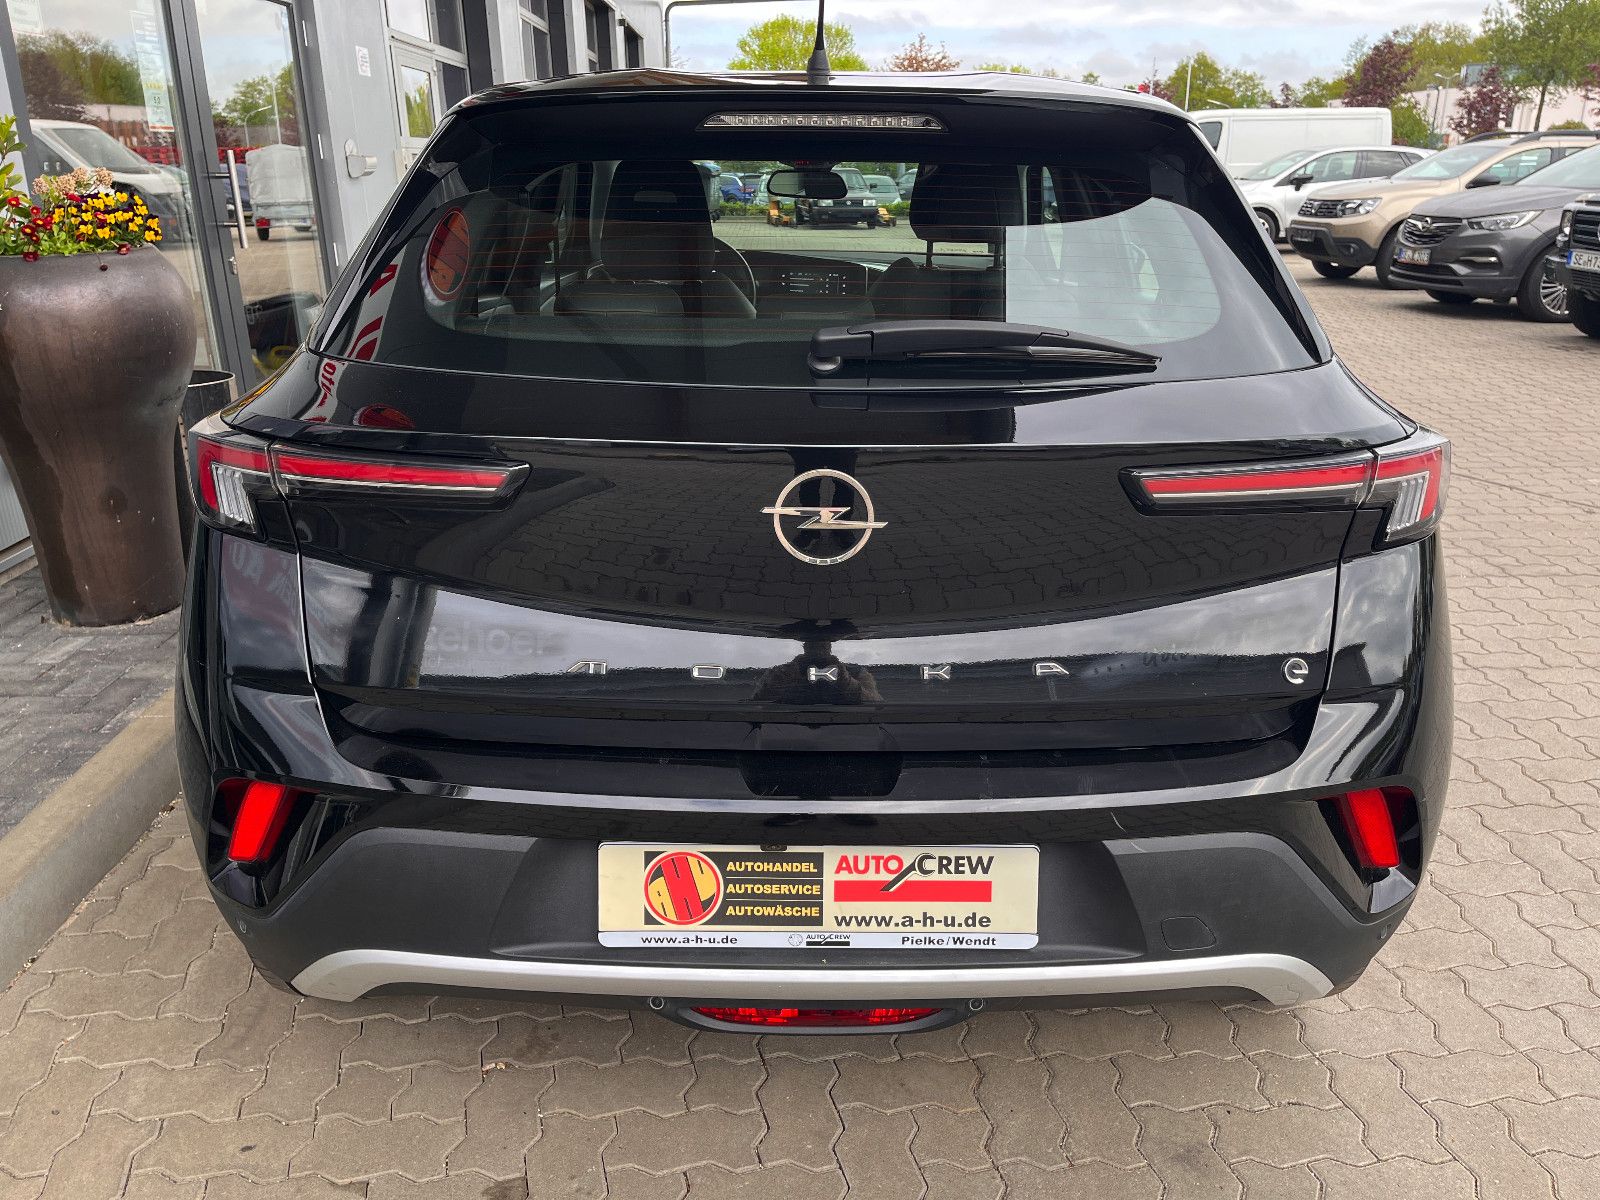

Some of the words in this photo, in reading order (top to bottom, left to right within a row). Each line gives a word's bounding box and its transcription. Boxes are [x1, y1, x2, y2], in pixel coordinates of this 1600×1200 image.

[726, 861, 818, 873] AUTOHANDEL
[834, 855, 904, 875] AUTO
[725, 883, 821, 895] AUTOSERVICE
[725, 904, 820, 917] AUTOWÄSCHE
[834, 911, 992, 929] www.a-h-u.de
[640, 935, 738, 945] www.a-h-u.de
